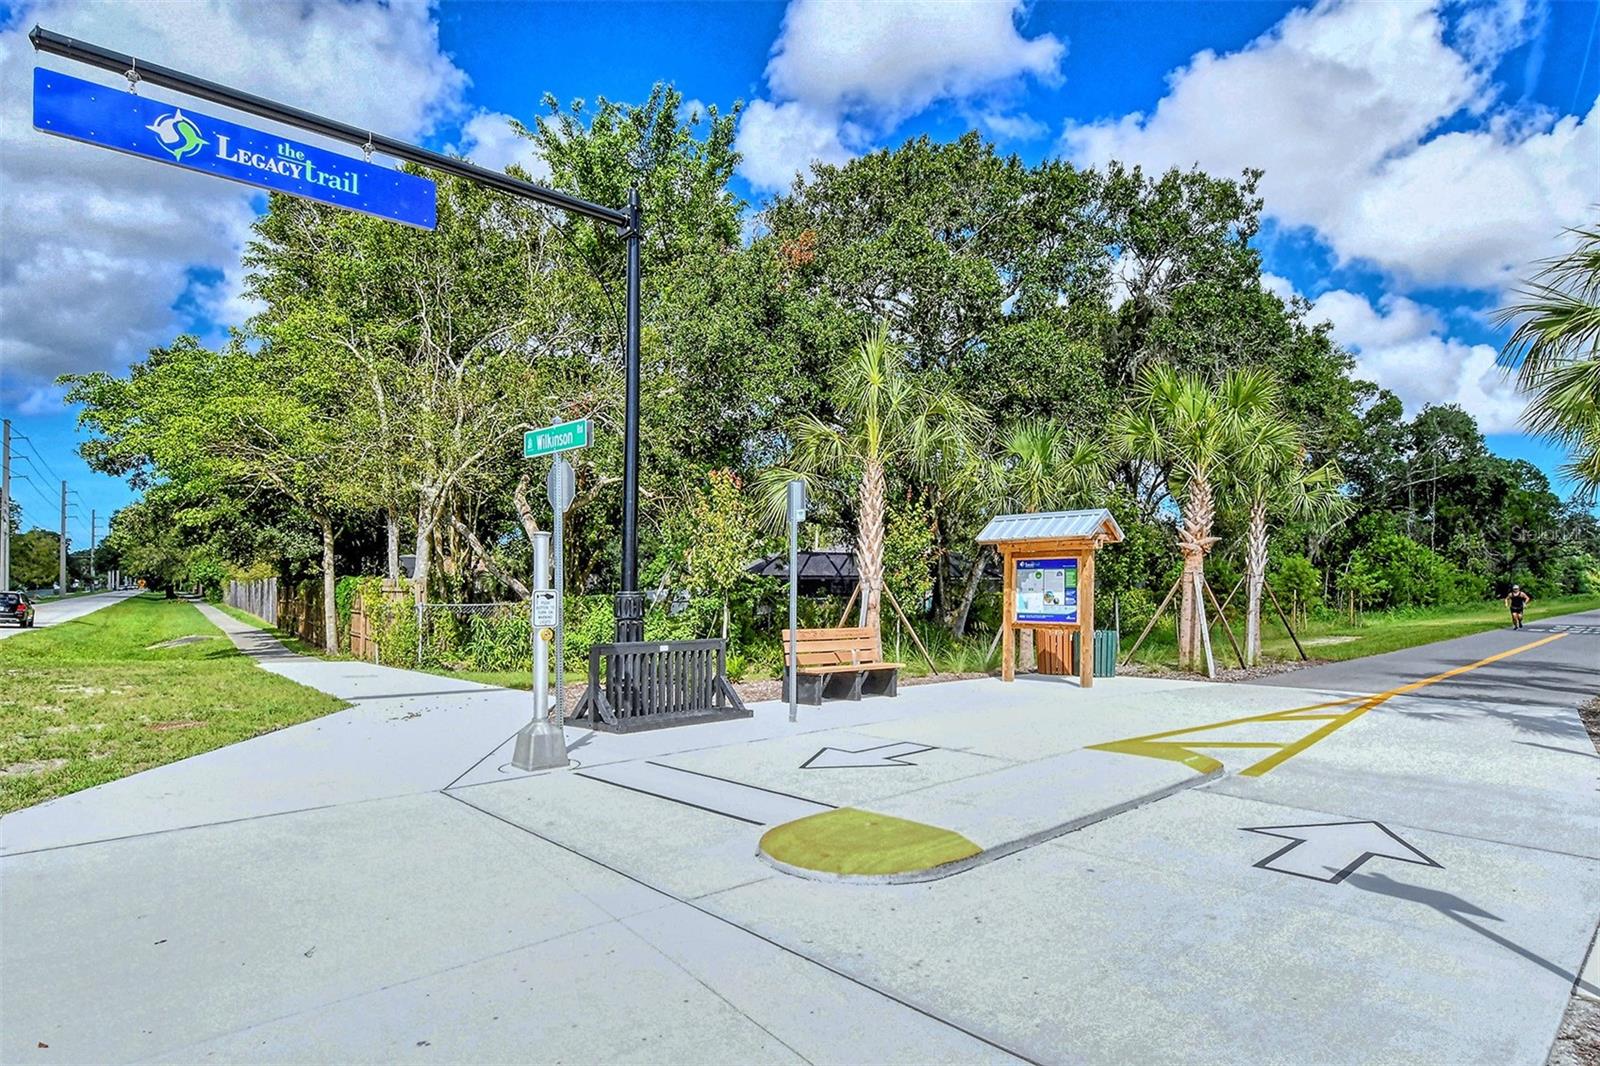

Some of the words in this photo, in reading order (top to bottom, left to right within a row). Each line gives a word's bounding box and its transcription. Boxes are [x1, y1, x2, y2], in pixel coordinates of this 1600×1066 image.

[277, 142, 305, 161] the
[216, 134, 302, 179] LEGACY
[305, 159, 359, 195] trail
[537, 432, 573, 450] Wilkinson
